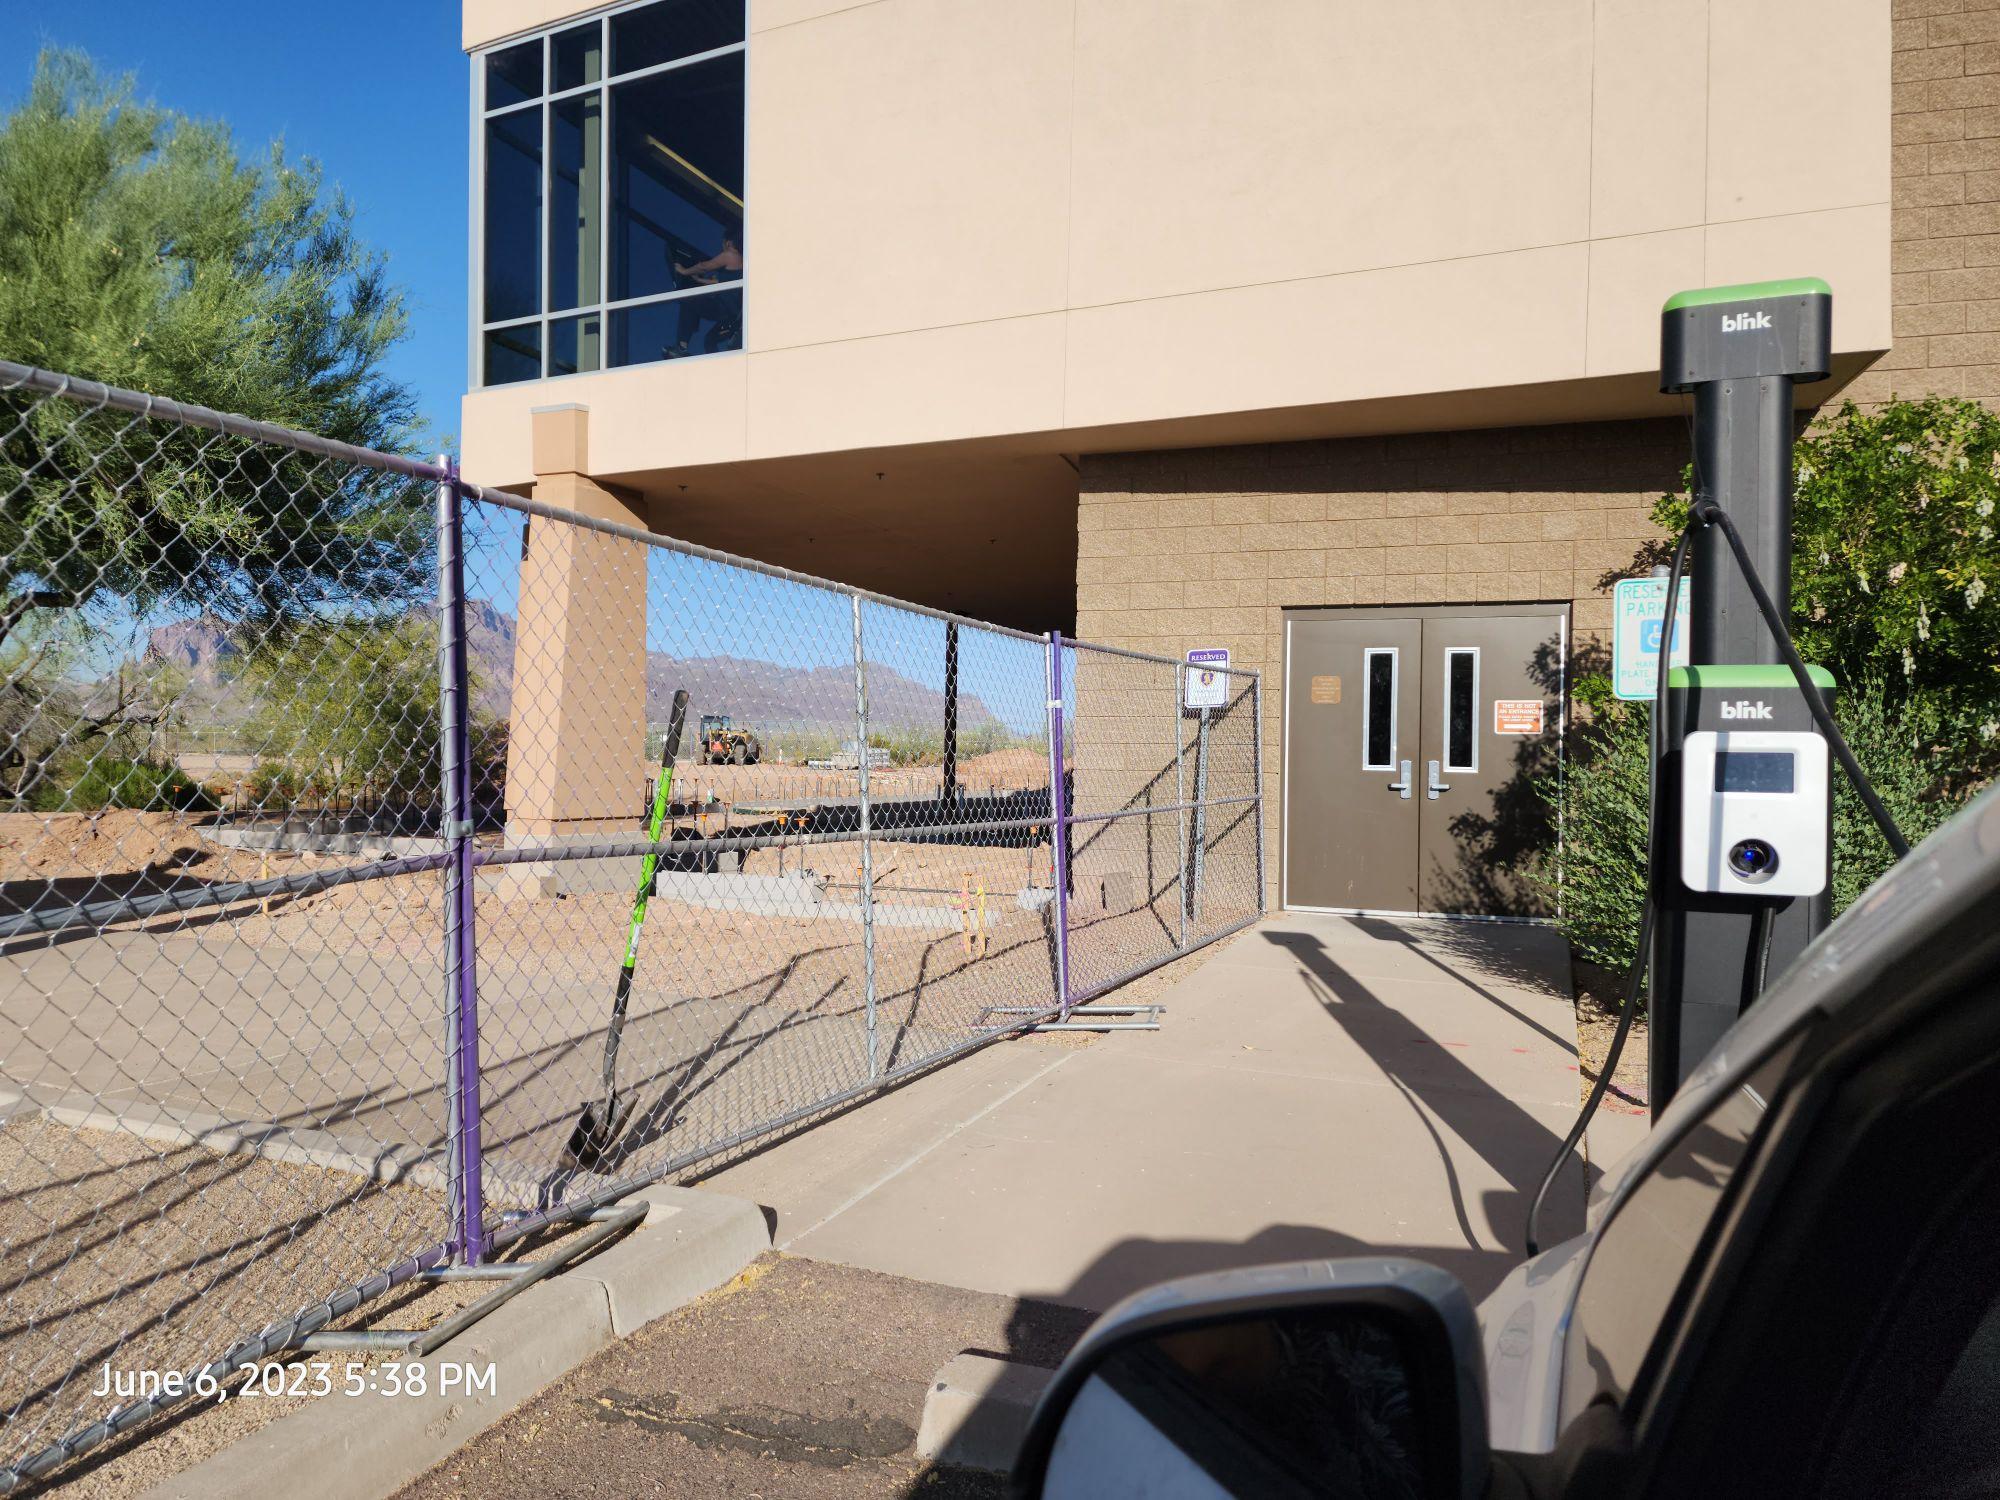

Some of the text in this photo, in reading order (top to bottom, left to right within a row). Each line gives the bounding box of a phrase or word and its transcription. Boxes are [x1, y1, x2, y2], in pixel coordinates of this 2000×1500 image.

[1722, 311, 1772, 333] blink
[1626, 601, 1690, 616] PARKNG
[1191, 653, 1226, 661] RESERVED
[1720, 700, 1773, 720] blink
